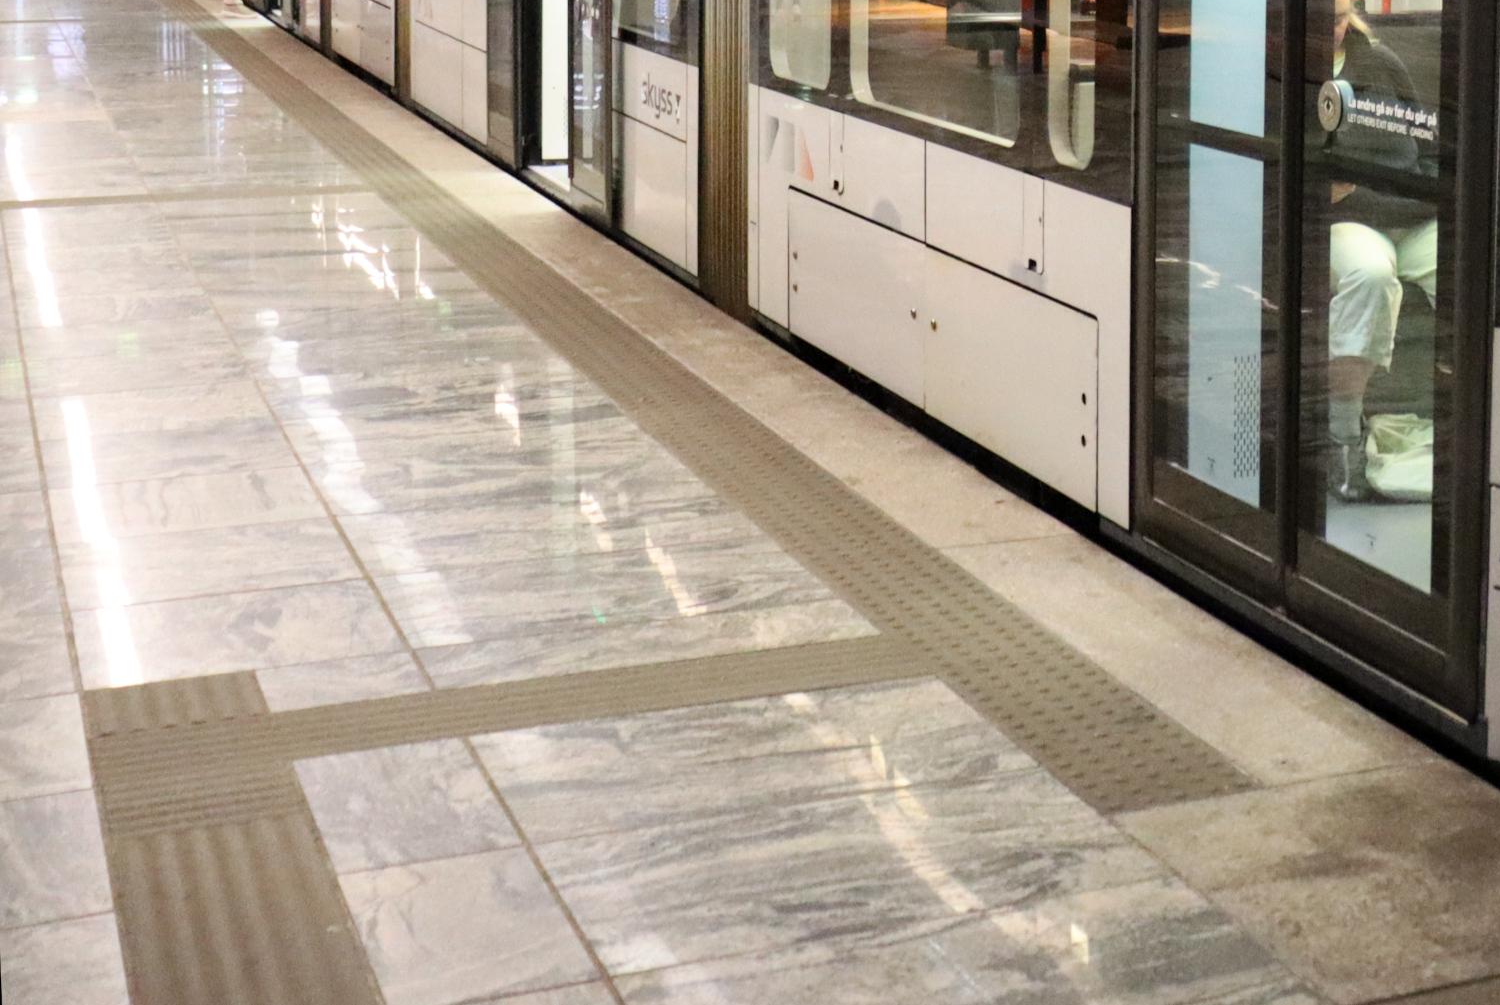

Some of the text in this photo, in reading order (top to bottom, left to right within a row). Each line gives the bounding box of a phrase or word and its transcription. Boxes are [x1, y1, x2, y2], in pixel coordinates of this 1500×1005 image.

[641, 72, 673, 119] skyss
[1347, 113, 1356, 123] LET
[1405, 107, 1414, 121] du
